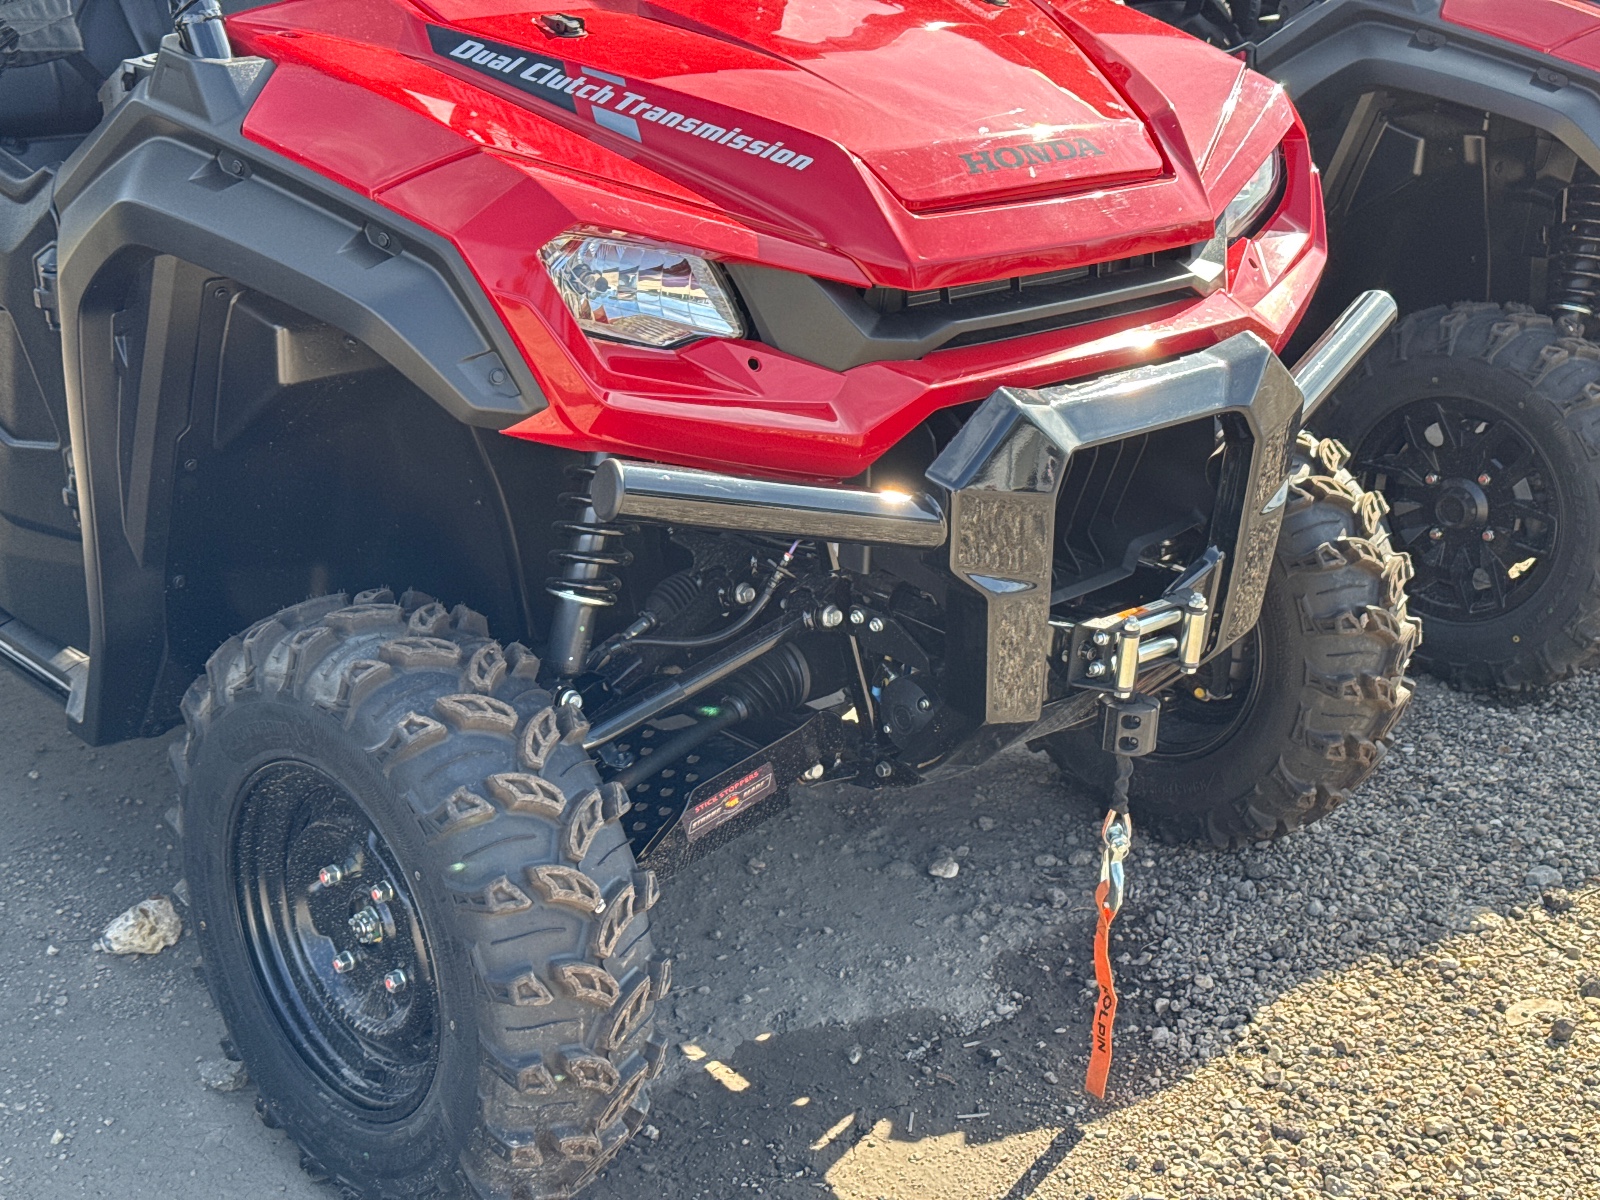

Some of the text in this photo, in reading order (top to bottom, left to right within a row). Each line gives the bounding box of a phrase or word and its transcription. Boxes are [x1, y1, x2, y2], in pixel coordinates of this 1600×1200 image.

[449, 39, 814, 171] Dual Clutch Transmission
[958, 137, 1106, 175] HONDA
[694, 795, 719, 814] STICK
[719, 770, 759, 798] STOPPERS
